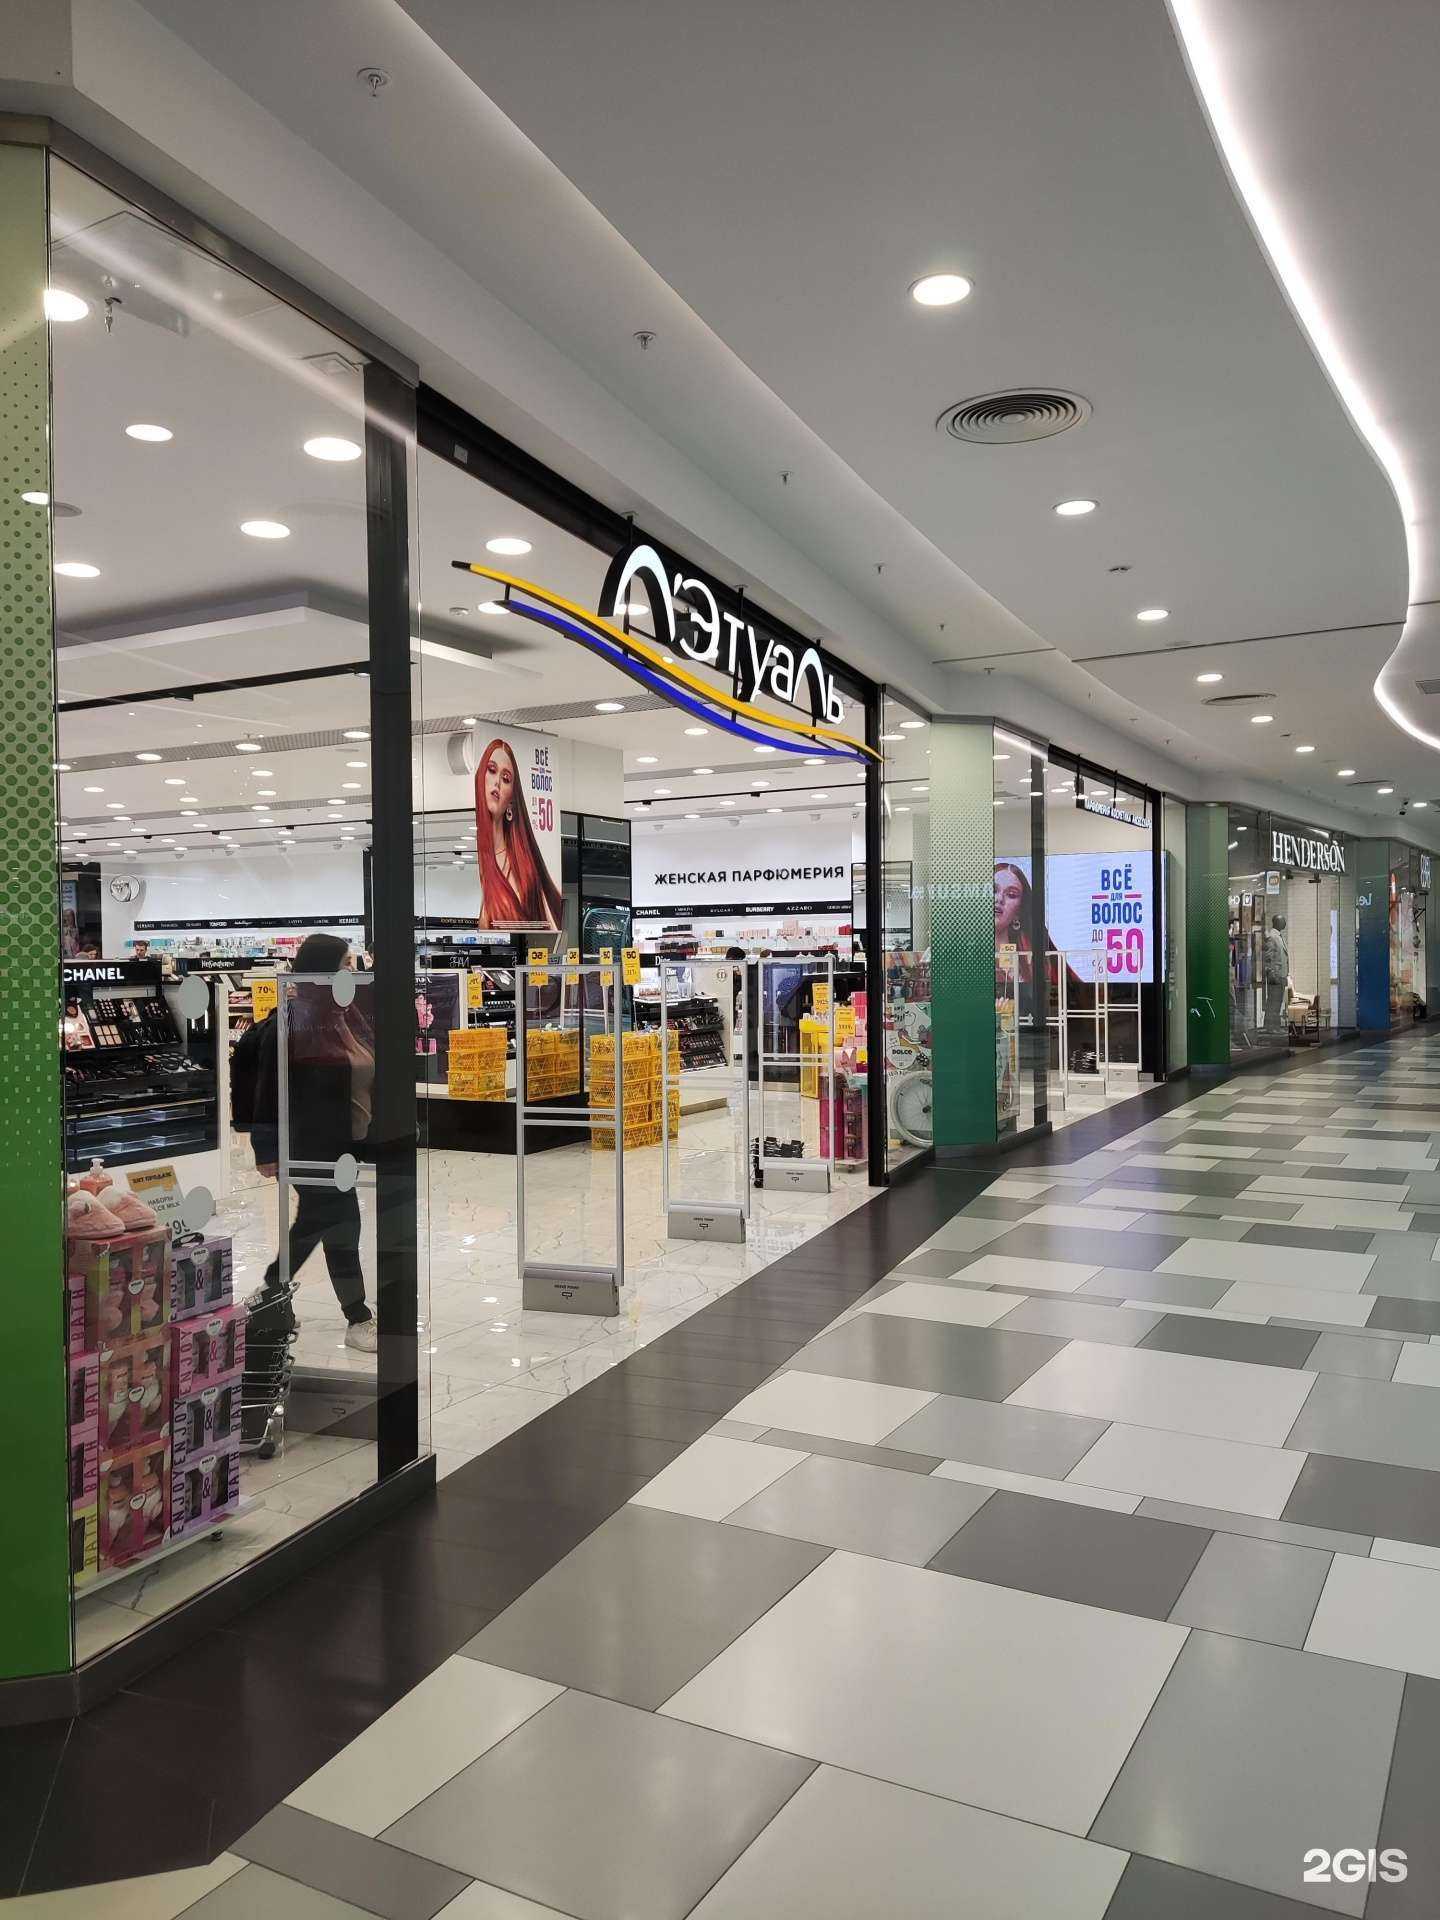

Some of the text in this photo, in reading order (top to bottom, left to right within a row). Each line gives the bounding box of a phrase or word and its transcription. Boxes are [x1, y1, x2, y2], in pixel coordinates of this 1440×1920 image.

[535, 748, 549, 767] ВСЁ
[531, 773, 553, 792] ВОЛОС
[538, 797, 554, 833] 50
[1272, 830, 1346, 874] HENDERSON
[655, 866, 844, 885] ЖЕНСКАЯ ПАРФЮМЕРИЯ
[1101, 863, 1133, 891] ВСЁ
[636, 908, 661, 916] CHANEL
[1091, 901, 1143, 925] ВОЛОС
[1110, 892, 1123, 901] ДЛЯ
[1092, 929, 1104, 943] ДО
[1106, 927, 1144, 974] 50
[63, 967, 125, 982] CHANEL
[222, 1247, 233, 1296] BATH
[72, 1287, 85, 1341] BATH
[180, 1329, 193, 1396] ENJOY
[235, 1317, 247, 1366] BATH
[85, 1364, 99, 1419] BATH
[174, 1384, 243, 1465] ENJOY & BATH
[84, 1439, 98, 1493] BATH
[172, 1450, 240, 1535] ENJOY & BATH
[84, 1513, 97, 1567] BATH
